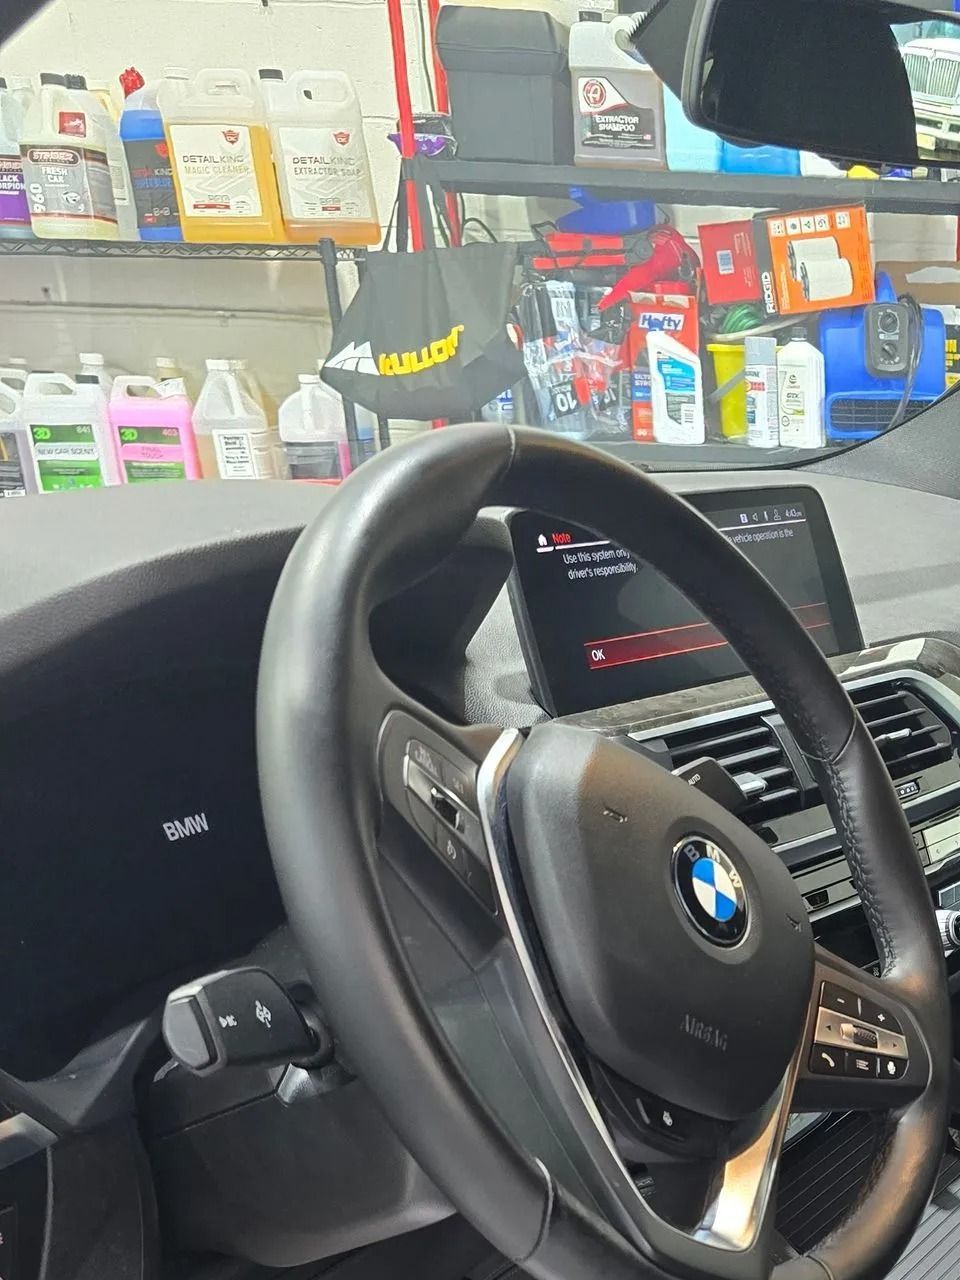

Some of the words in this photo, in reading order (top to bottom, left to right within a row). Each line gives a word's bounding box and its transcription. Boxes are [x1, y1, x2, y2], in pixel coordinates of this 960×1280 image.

[595, 115, 639, 123] EXTRACTOR
[42, 167, 68, 176] FRESH
[184, 166, 210, 174] MAGIC
[48, 175, 65, 183] CAR
[761, 272, 777, 313] RIDGID
[33, 427, 51, 440] 3D
[121, 428, 138, 441] 3D
[551, 533, 571, 544] Note
[733, 533, 752, 544] vehicle
[753, 531, 778, 543] operation
[784, 528, 794, 538] the
[563, 553, 576, 564] Use
[579, 551, 592, 562] this
[592, 549, 615, 562] system
[568, 566, 593, 580] driver's
[591, 649, 606, 661] OK
[688, 773, 701, 786] AUTO
[163, 812, 208, 841] BMW
